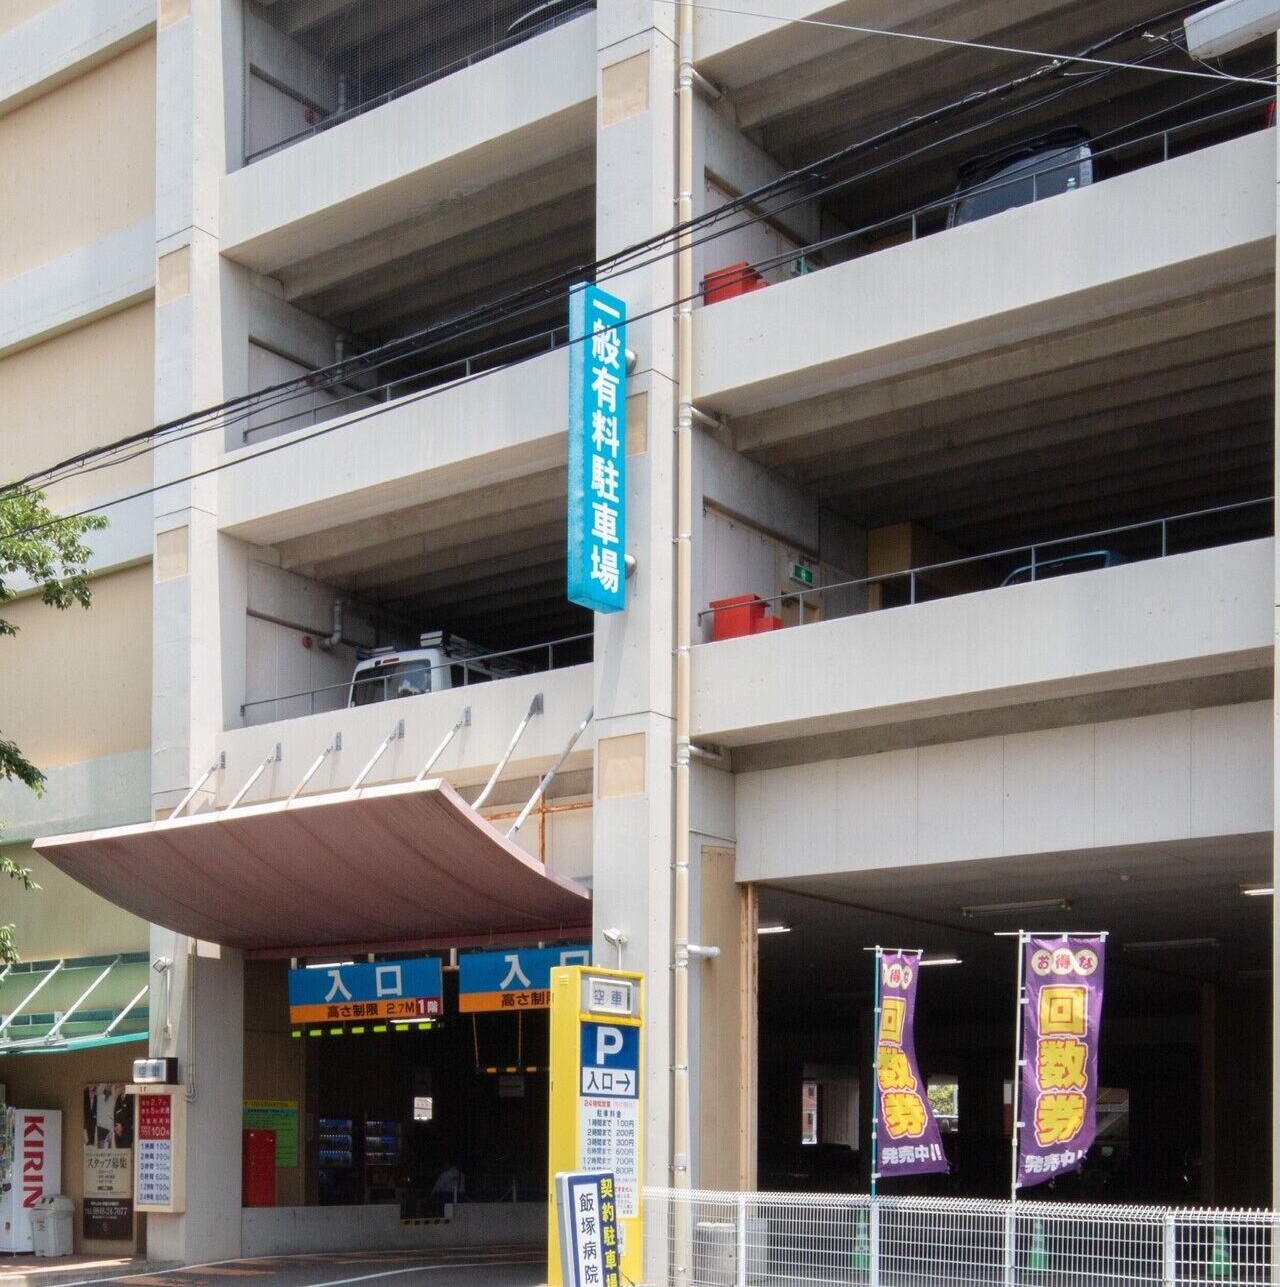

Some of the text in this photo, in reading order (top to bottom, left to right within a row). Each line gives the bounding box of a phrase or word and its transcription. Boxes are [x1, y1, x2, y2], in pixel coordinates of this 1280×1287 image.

[590, 298, 620, 594] 一般有料駐車場
[324, 965, 402, 1002] 入口
[1036, 954, 1094, 971] お得な
[327, 1003, 379, 1019] 高さ制限
[593, 989, 623, 1008] 空車
[596, 1026, 624, 1065] P
[877, 996, 928, 1139] 回数券
[1034, 984, 1089, 1147] 回数券
[586, 1070, 613, 1091] 入口
[23, 1115, 45, 1209] KIRIN
[579, 1193, 599, 1284] 飯塚病院
[600, 1178, 618, 1287] 契約駐車場
